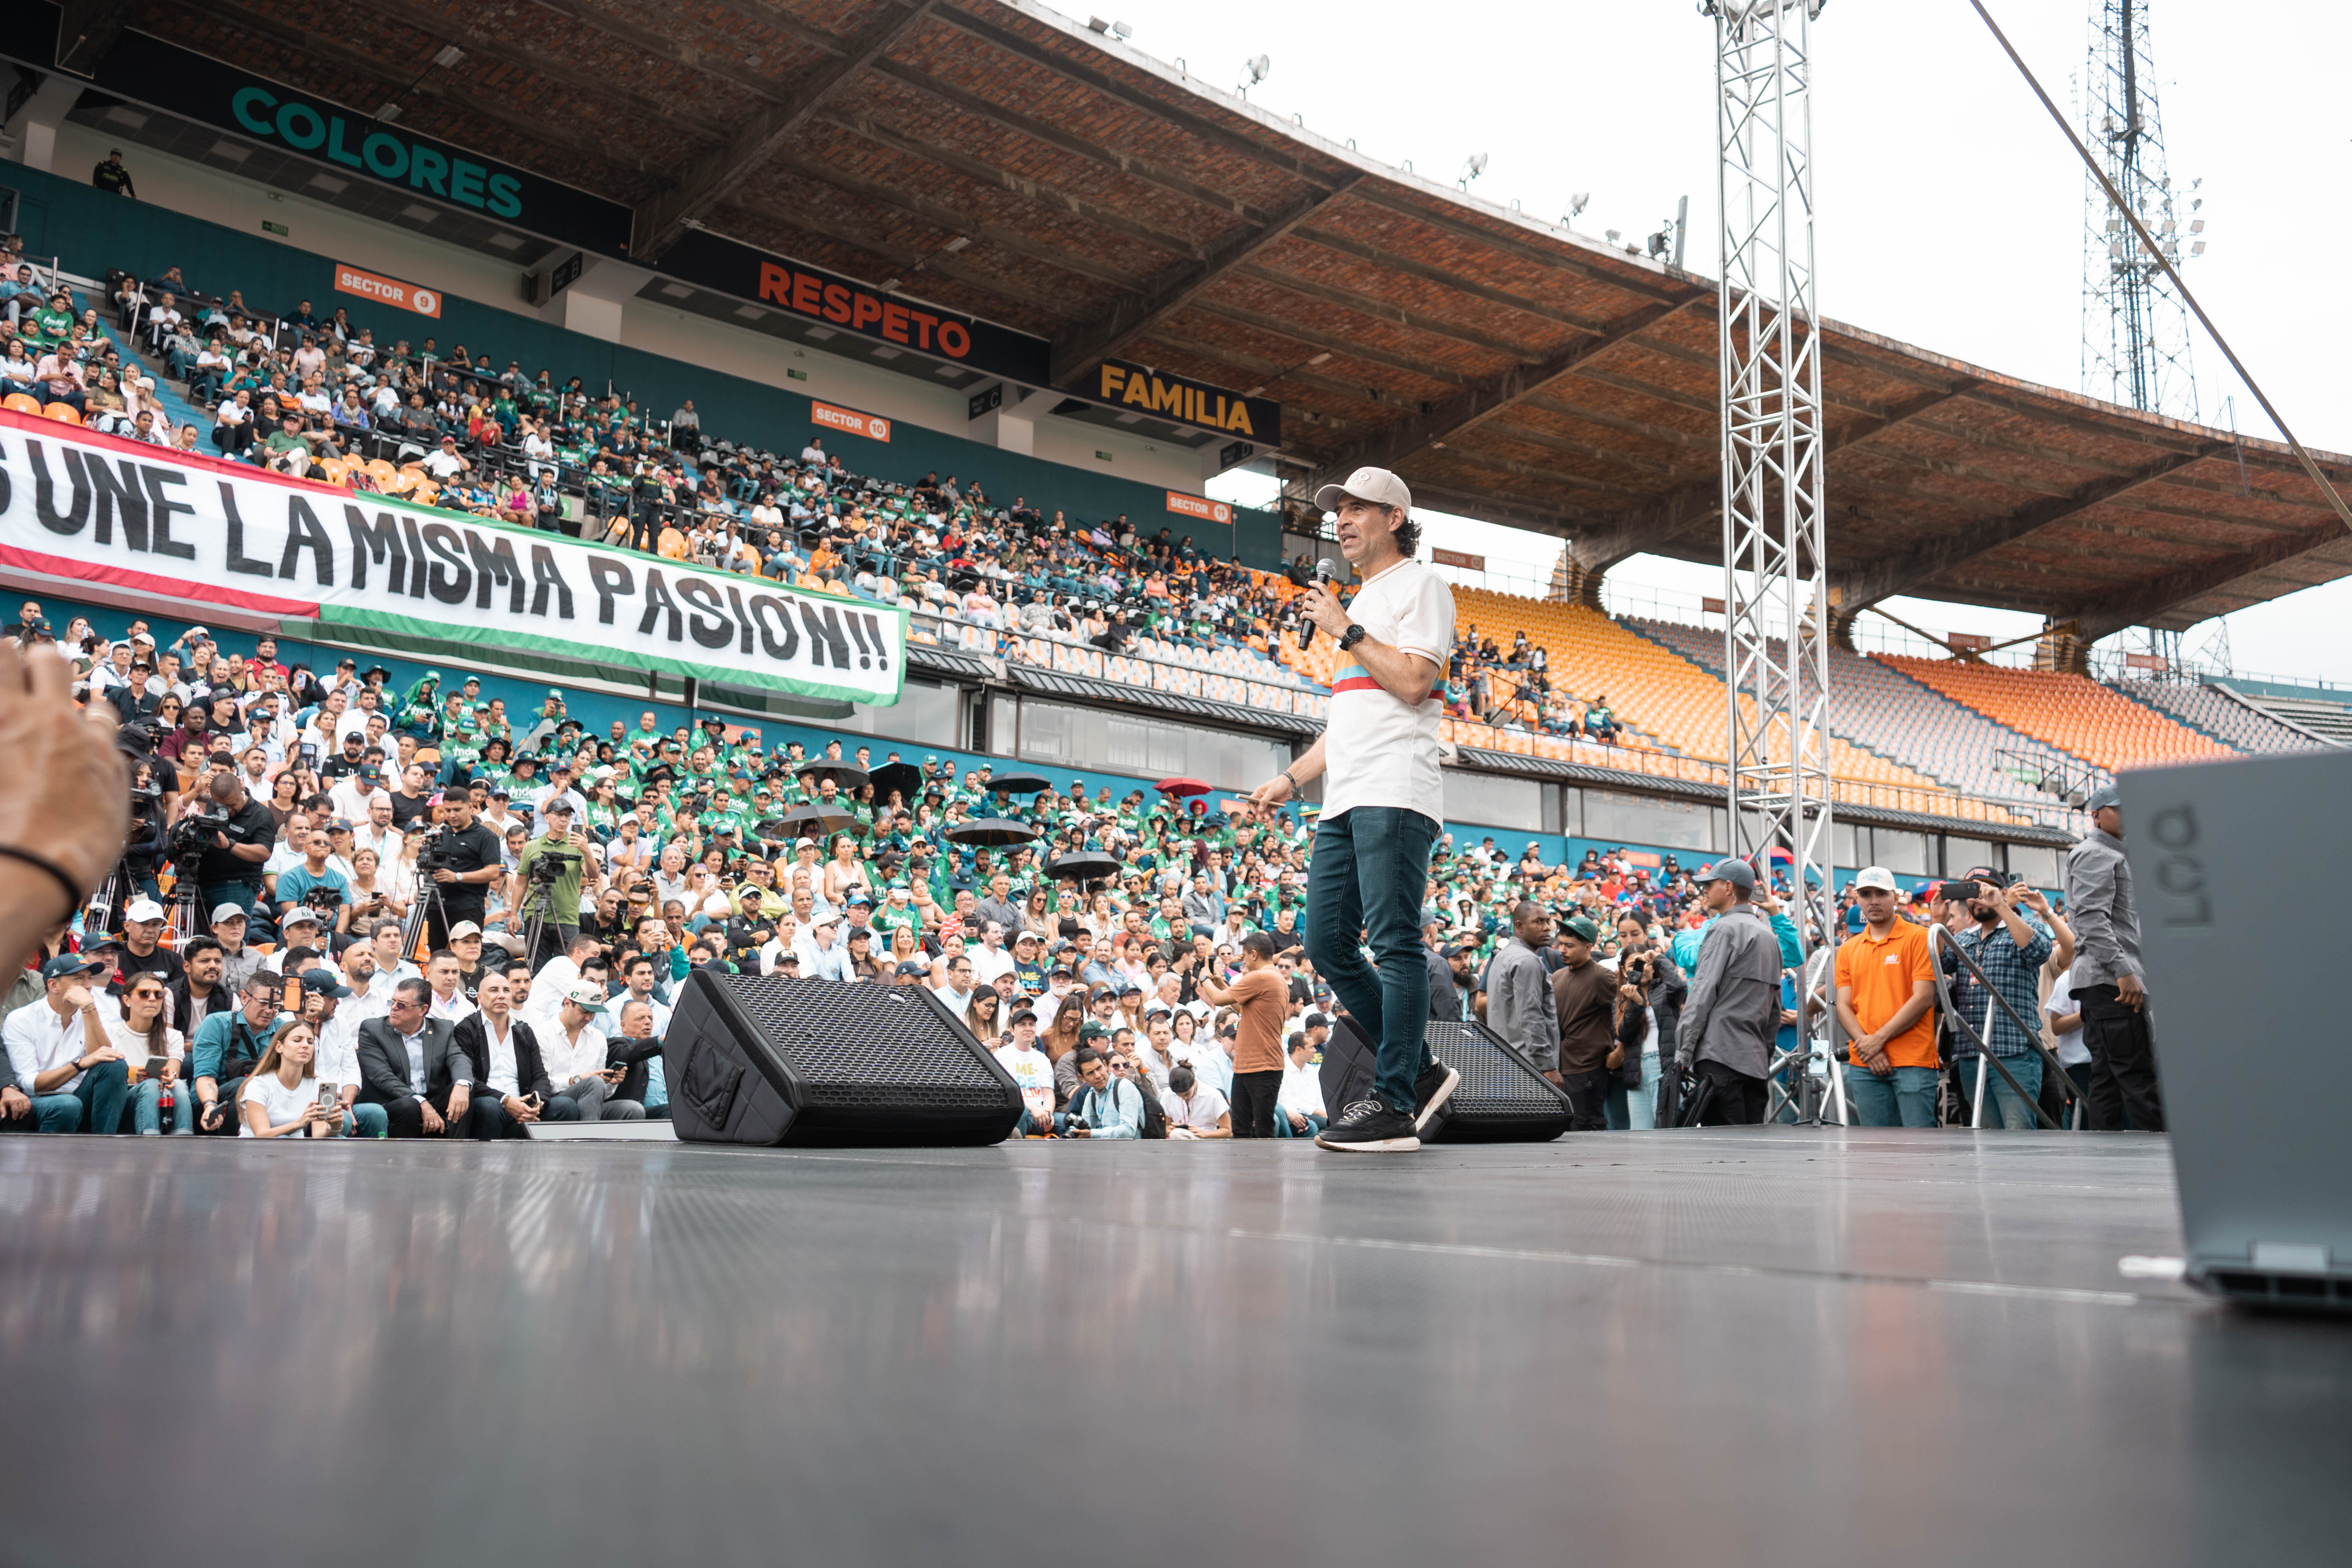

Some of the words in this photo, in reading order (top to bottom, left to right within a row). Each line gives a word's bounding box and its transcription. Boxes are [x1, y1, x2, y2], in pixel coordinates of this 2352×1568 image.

[232, 87, 522, 218] COLORES
[572, 260, 579, 279] B
[342, 273, 403, 302] SECTOR
[420, 295, 429, 308] 9
[758, 261, 971, 358] RESPETO
[990, 392, 999, 407] C
[1101, 364, 1253, 435] FAMILIA
[817, 408, 862, 430] SECTOR
[1242, 443, 1250, 457] D
[1170, 497, 1208, 514] SECTOR
[26, 439, 195, 561] UNE
[217, 481, 334, 587] LA
[344, 503, 574, 619] MISMA
[588, 555, 888, 671] PASIÓN!!
[1436, 552, 1467, 565] SECTOR
[1950, 636, 1976, 645] SECTOR
[2128, 657, 2153, 666] SECTOR
[1974, 868, 1991, 877] YORK
[1019, 971, 1041, 981] ME-
[1021, 980, 1043, 989] DE-
[571, 991, 580, 999] 47
[1015, 1062, 1039, 1075] ME-
